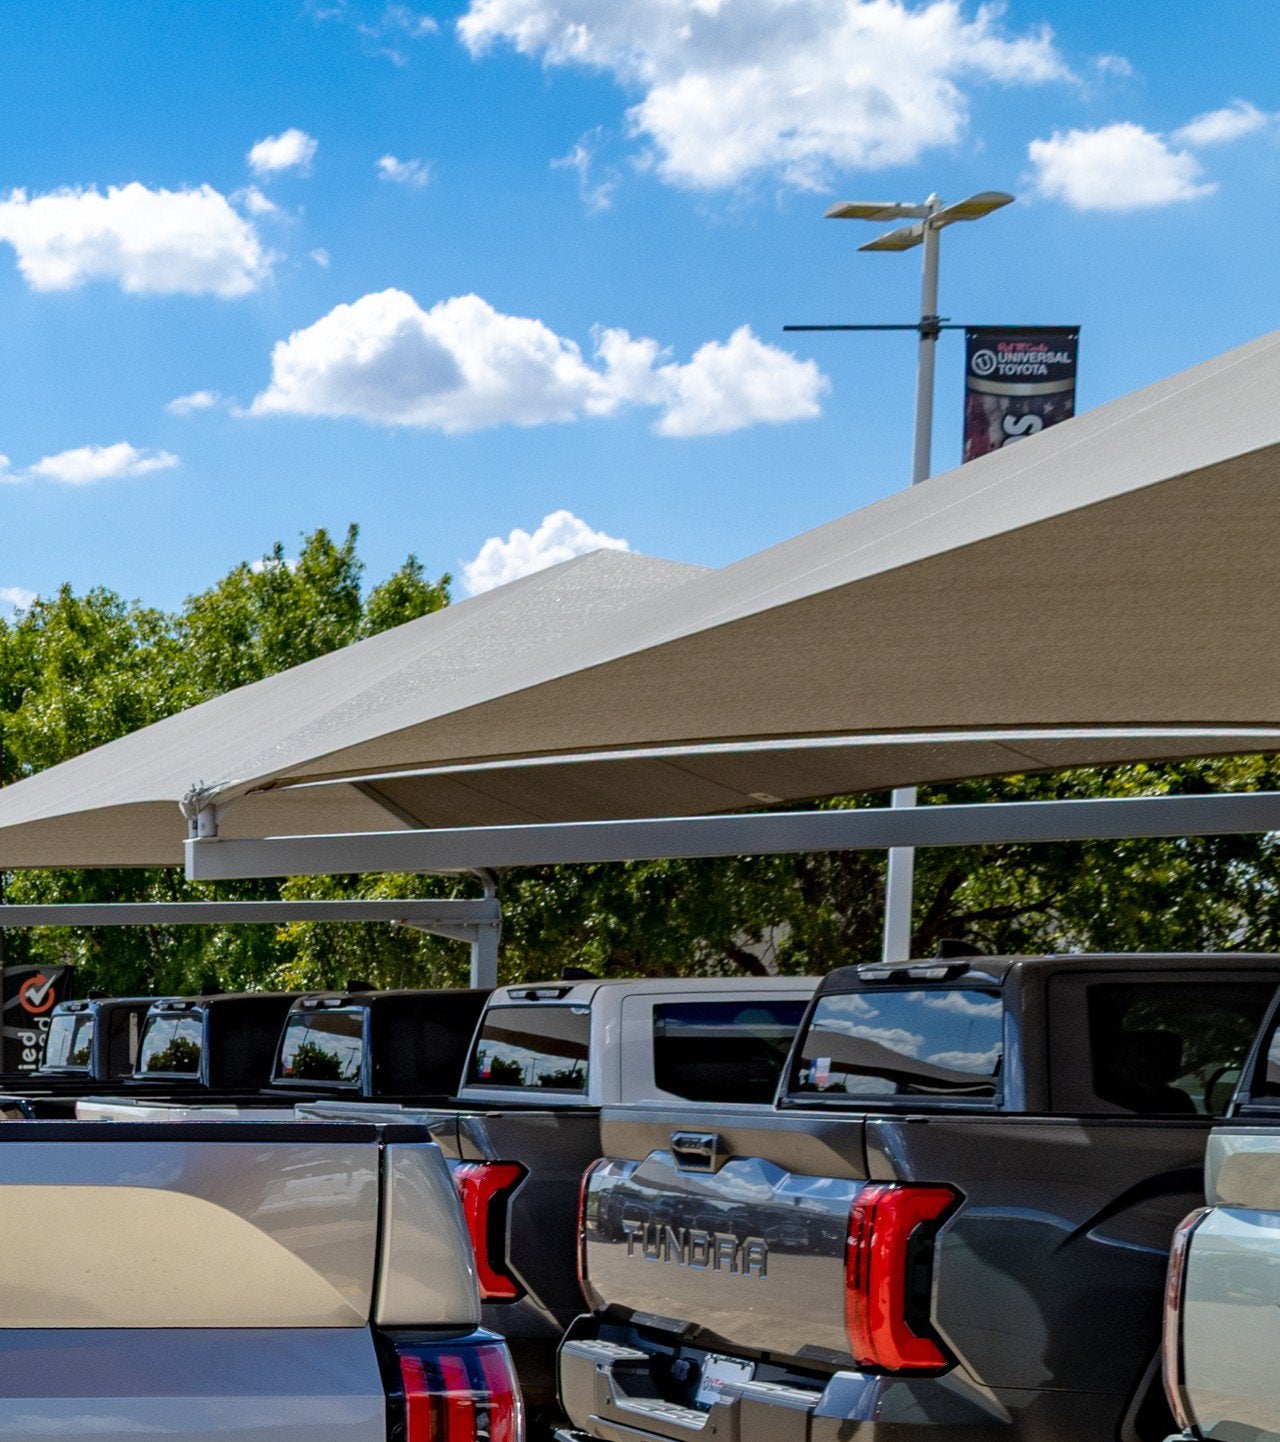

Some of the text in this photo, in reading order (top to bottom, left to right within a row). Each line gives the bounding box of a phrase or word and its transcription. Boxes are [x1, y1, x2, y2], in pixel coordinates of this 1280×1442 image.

[997, 351, 1072, 364] UNIVERSAL
[998, 363, 1048, 375] TOYOTA
[621, 1218, 769, 1280] TUNDRA
